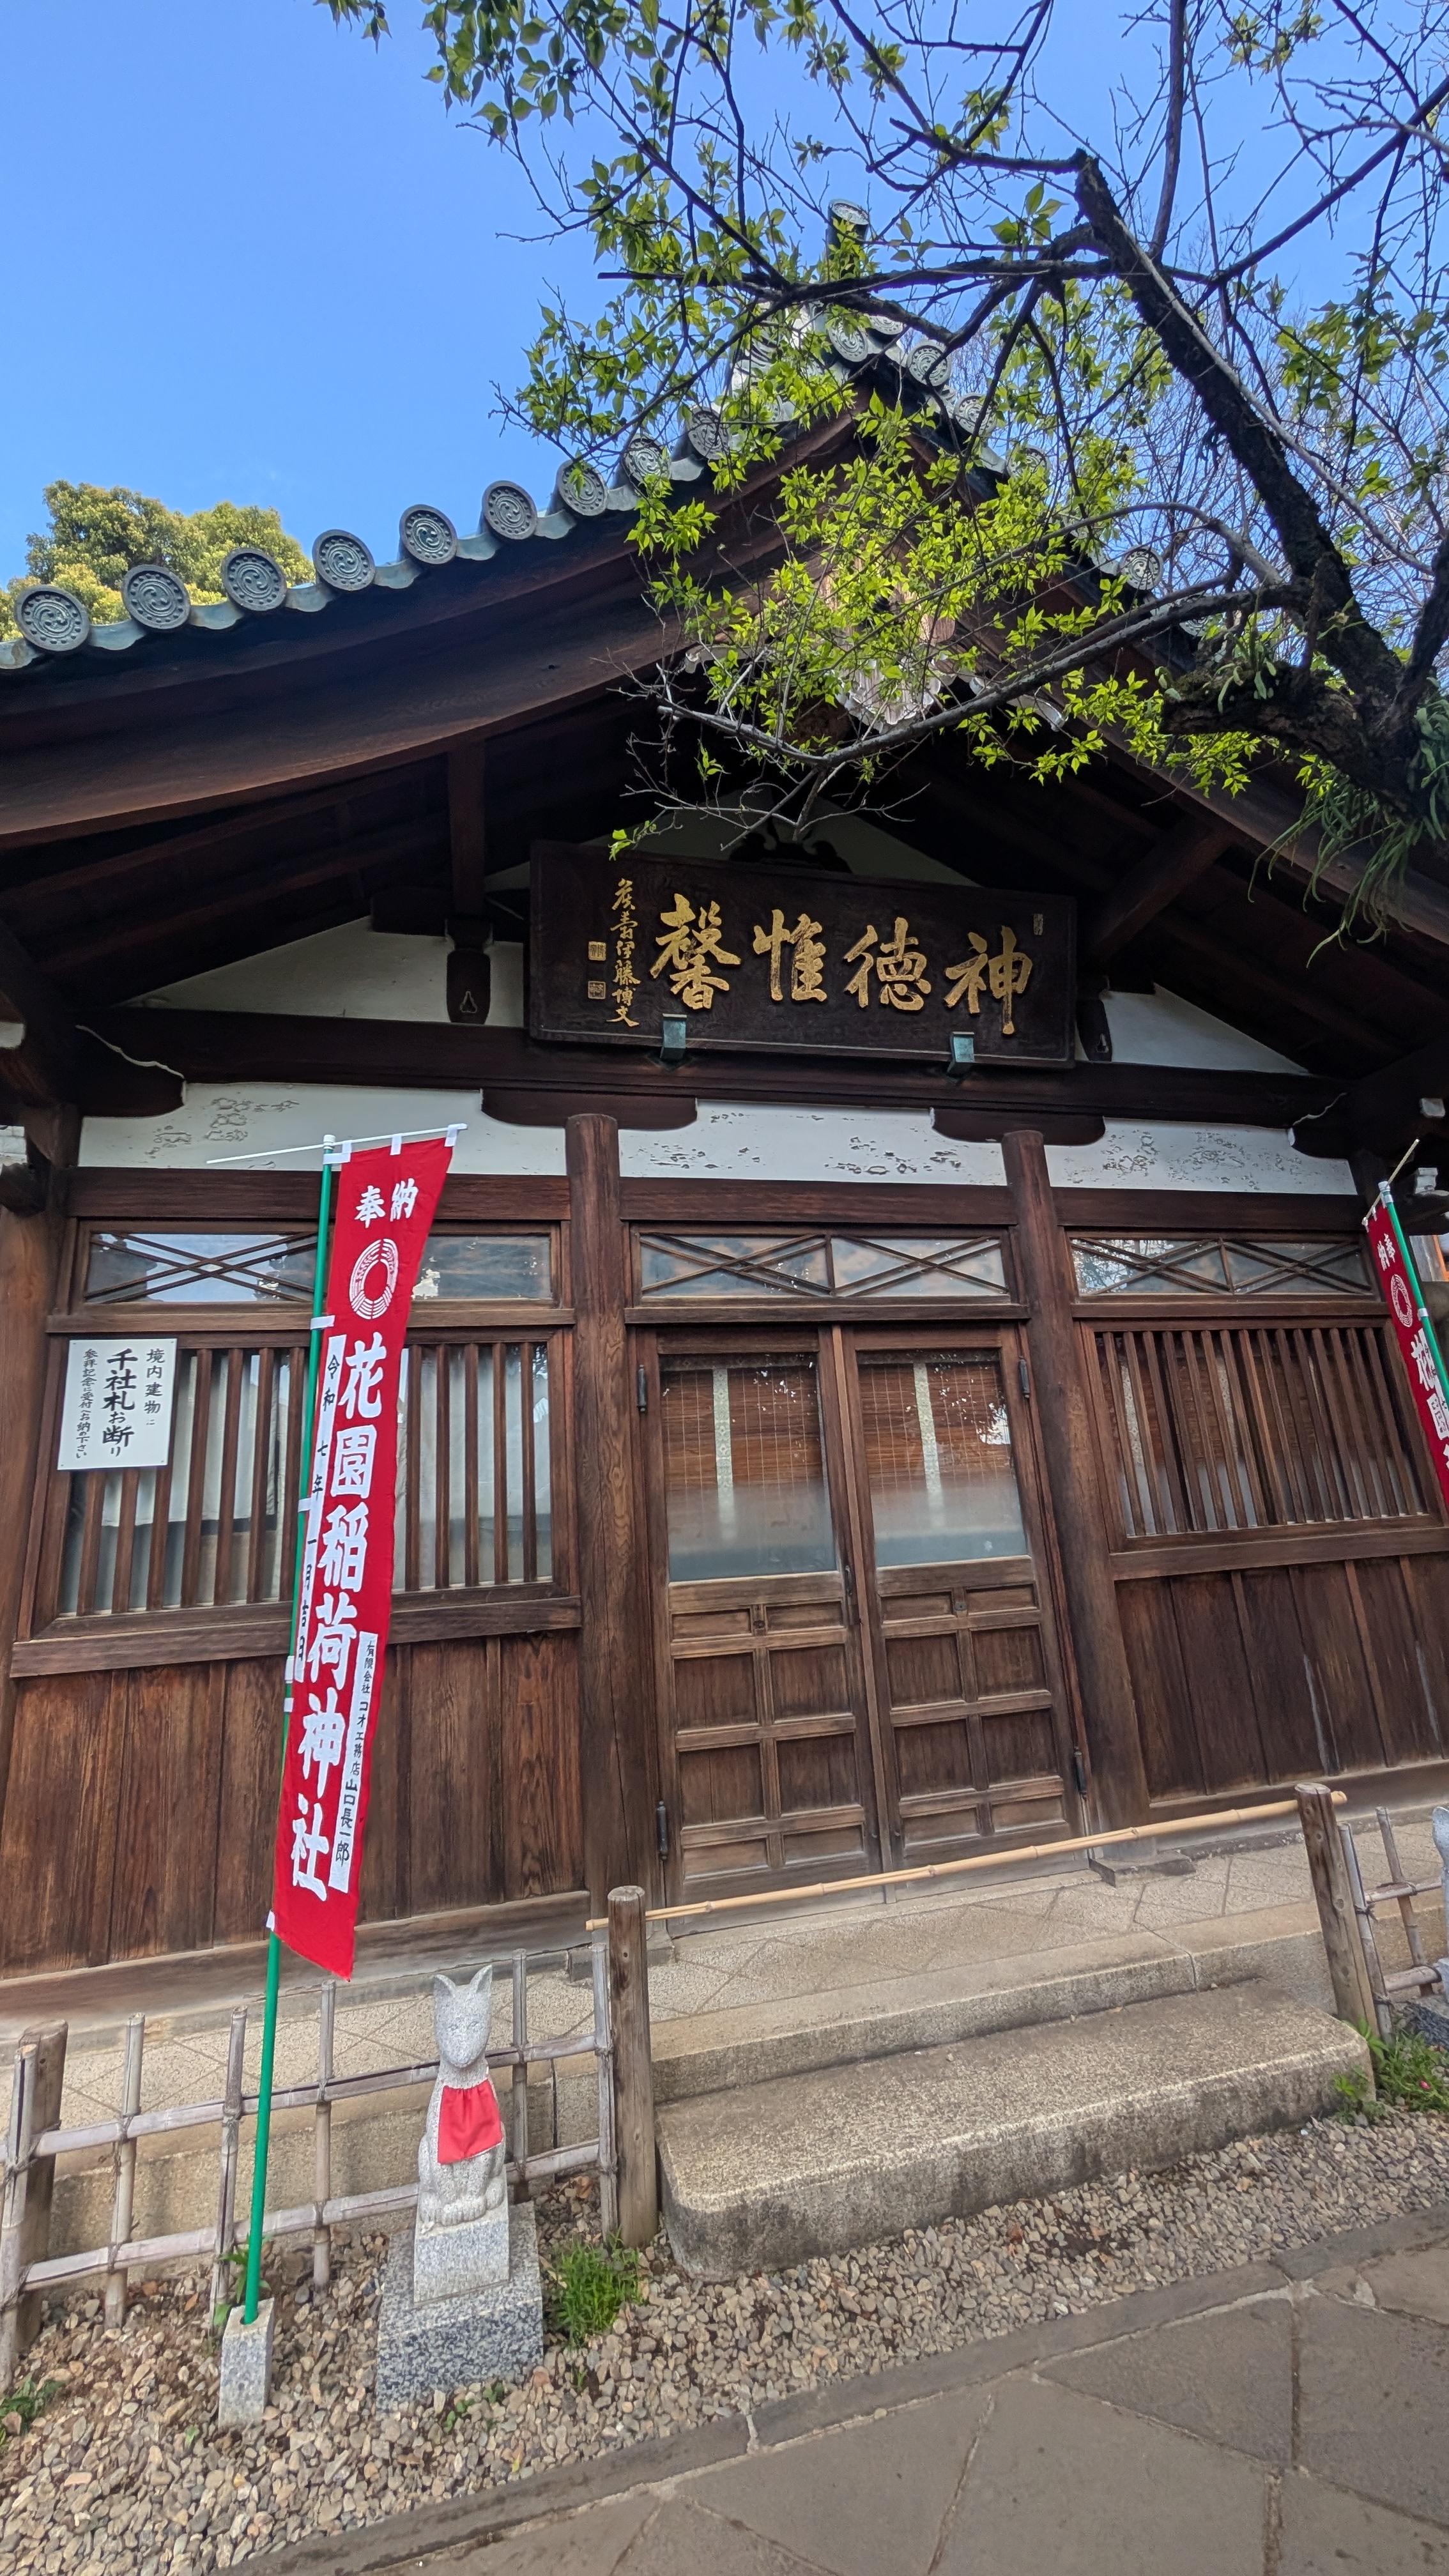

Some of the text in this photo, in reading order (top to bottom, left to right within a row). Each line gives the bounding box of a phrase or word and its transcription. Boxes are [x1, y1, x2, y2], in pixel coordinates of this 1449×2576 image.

[355, 1177, 418, 1229] 奉納
[100, 1348, 139, 1457] 千社札お断り
[143, 1348, 165, 1426] 境内建物に
[292, 1331, 387, 1901] 花園稲荷神社
